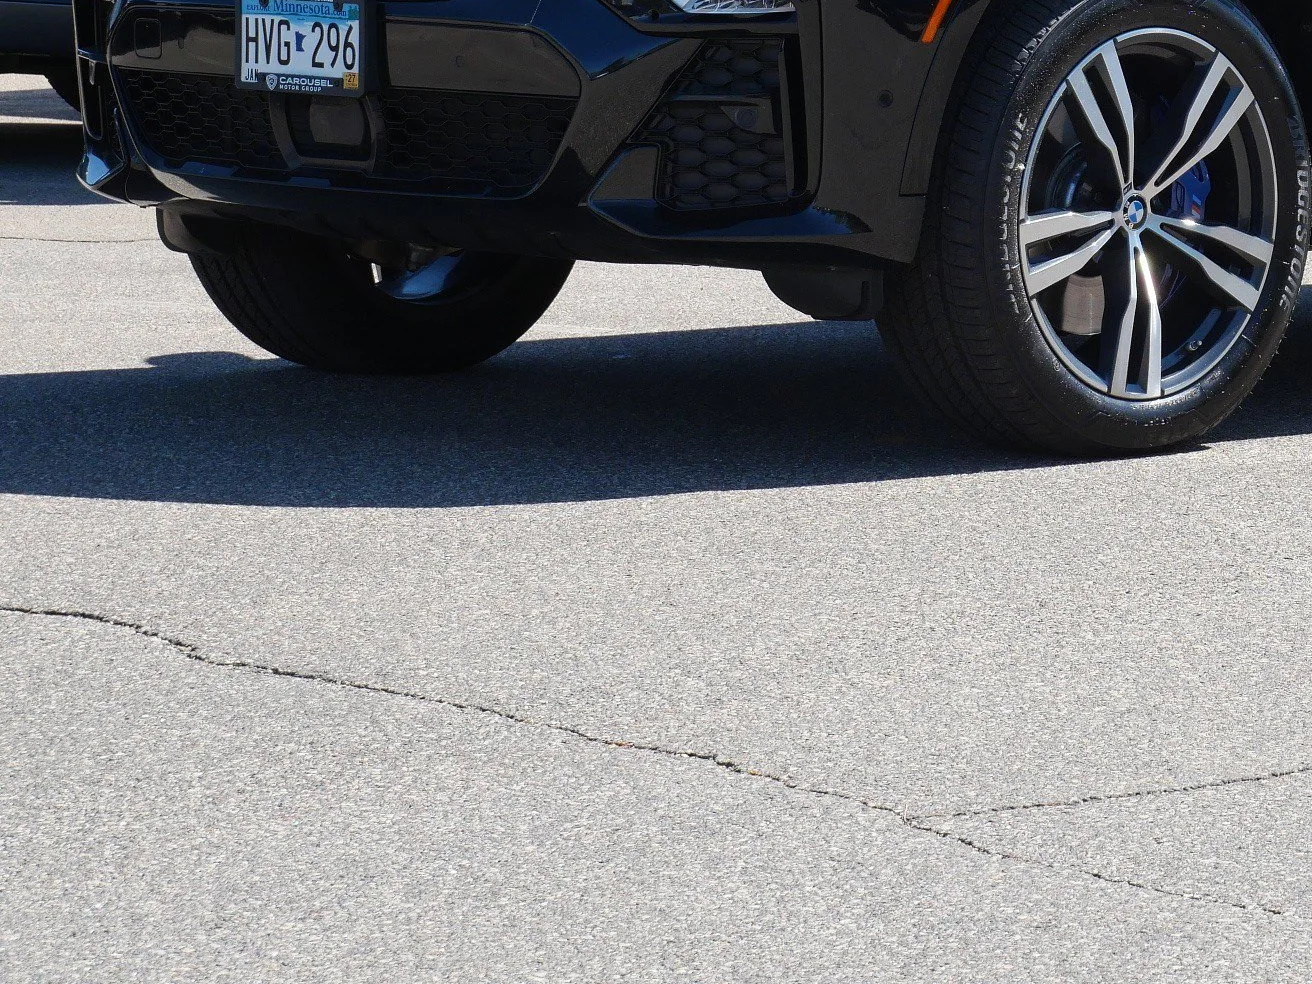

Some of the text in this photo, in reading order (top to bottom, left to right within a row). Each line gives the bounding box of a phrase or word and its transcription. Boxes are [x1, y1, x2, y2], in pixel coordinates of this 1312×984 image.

[245, 16, 356, 71] HVG 296
[245, 67, 259, 82] JAN
[279, 76, 334, 87] CAROUSEL
